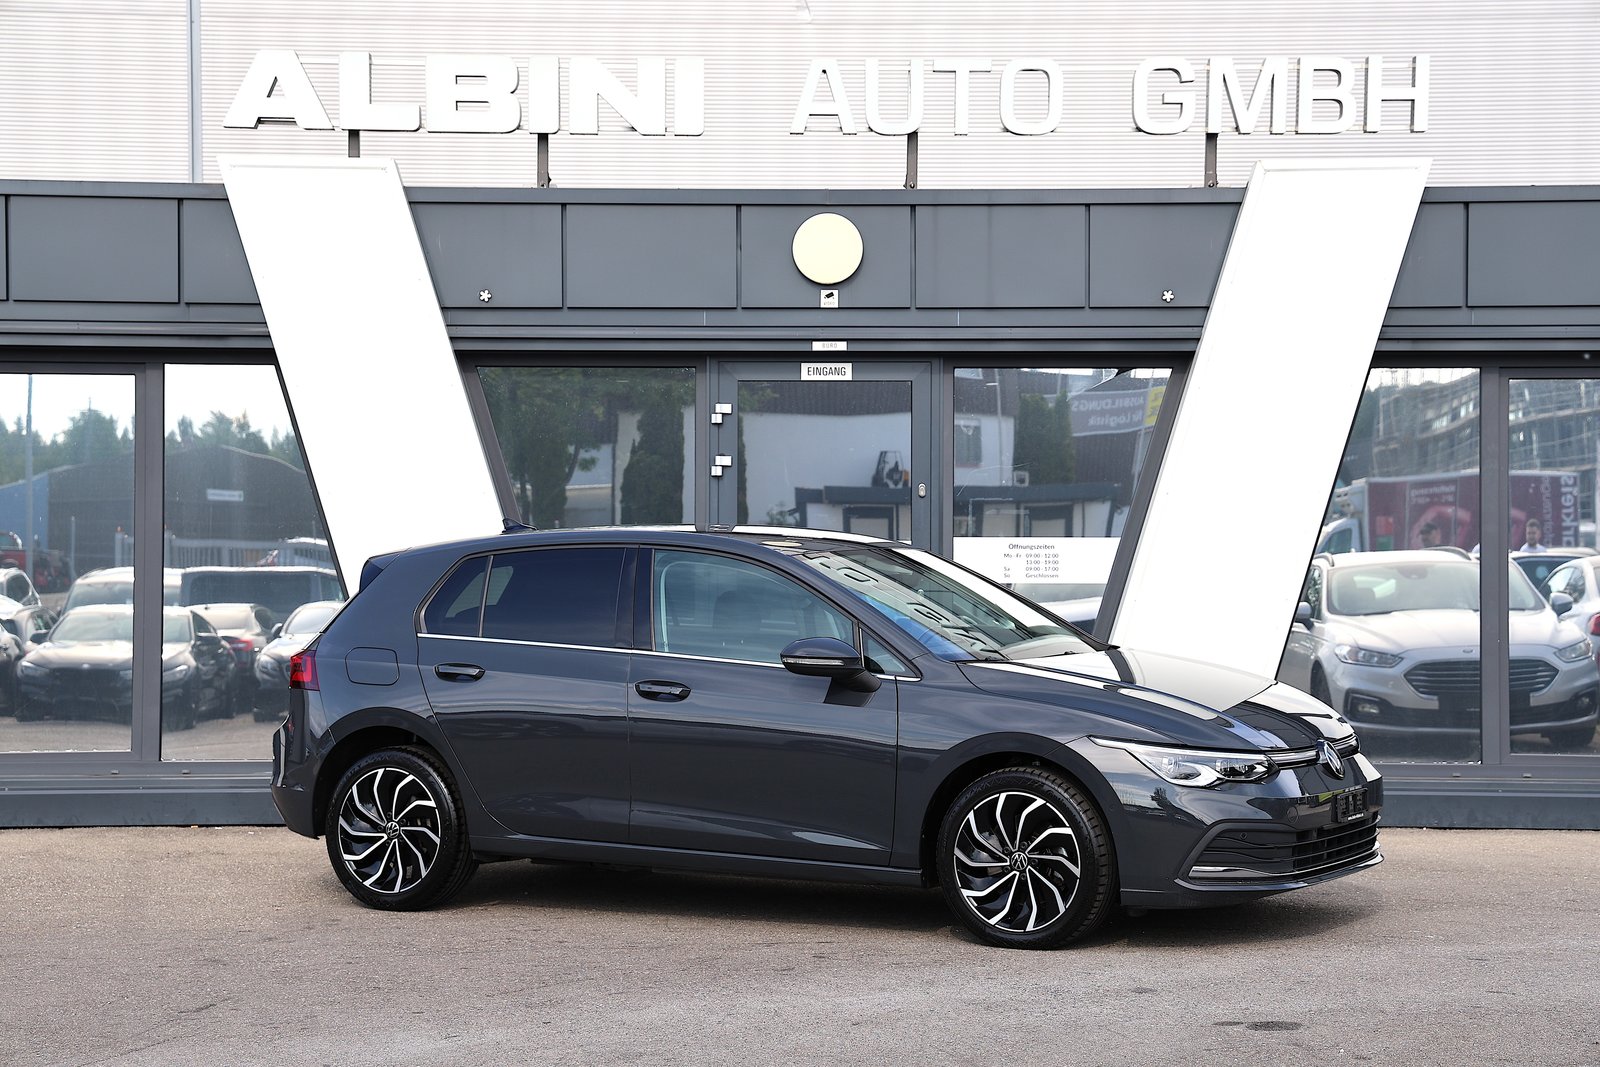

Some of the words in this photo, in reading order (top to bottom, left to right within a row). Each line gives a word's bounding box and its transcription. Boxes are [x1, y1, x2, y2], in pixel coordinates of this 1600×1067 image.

[223, 50, 705, 136] ALBINI
[790, 57, 1064, 136] AUTO
[1132, 54, 1431, 136] GMBH
[807, 366, 846, 376] EINGANG
